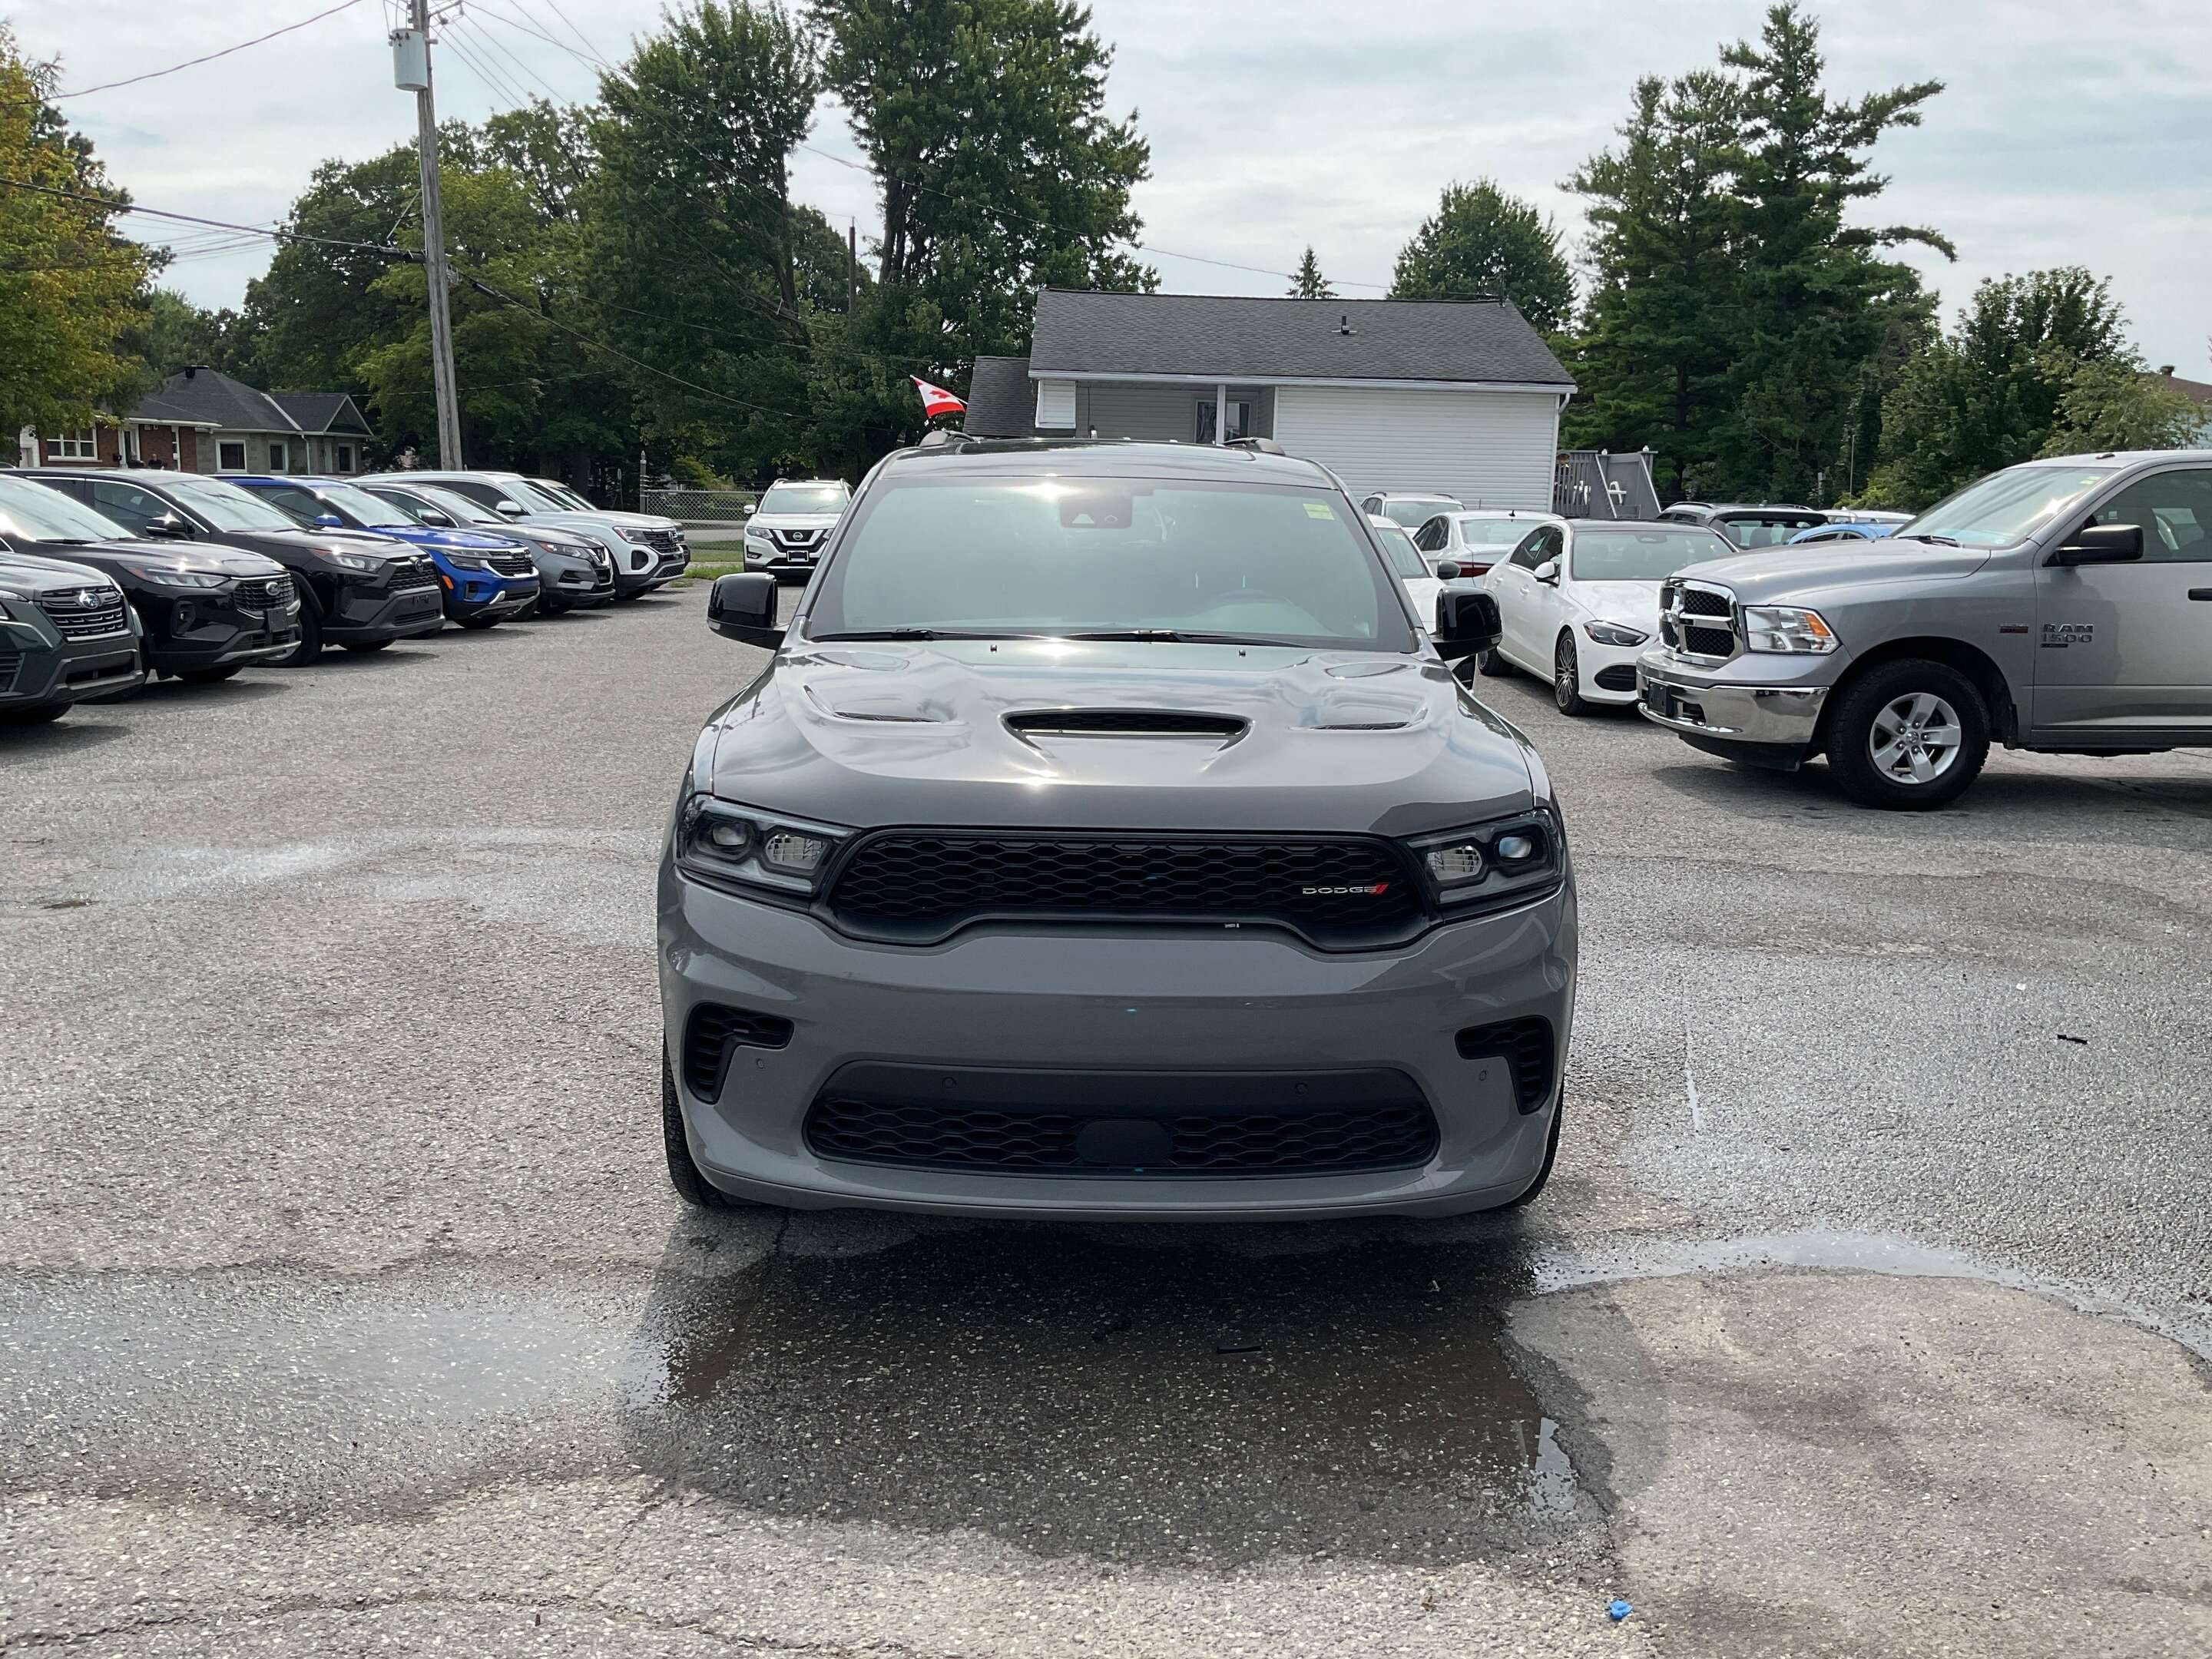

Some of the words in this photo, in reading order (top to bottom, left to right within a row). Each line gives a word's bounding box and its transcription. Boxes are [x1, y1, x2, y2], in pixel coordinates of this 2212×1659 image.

[2042, 623, 2094, 634] RAM
[2043, 634, 2093, 643] 1500
[1302, 886, 1377, 895] DODGE
